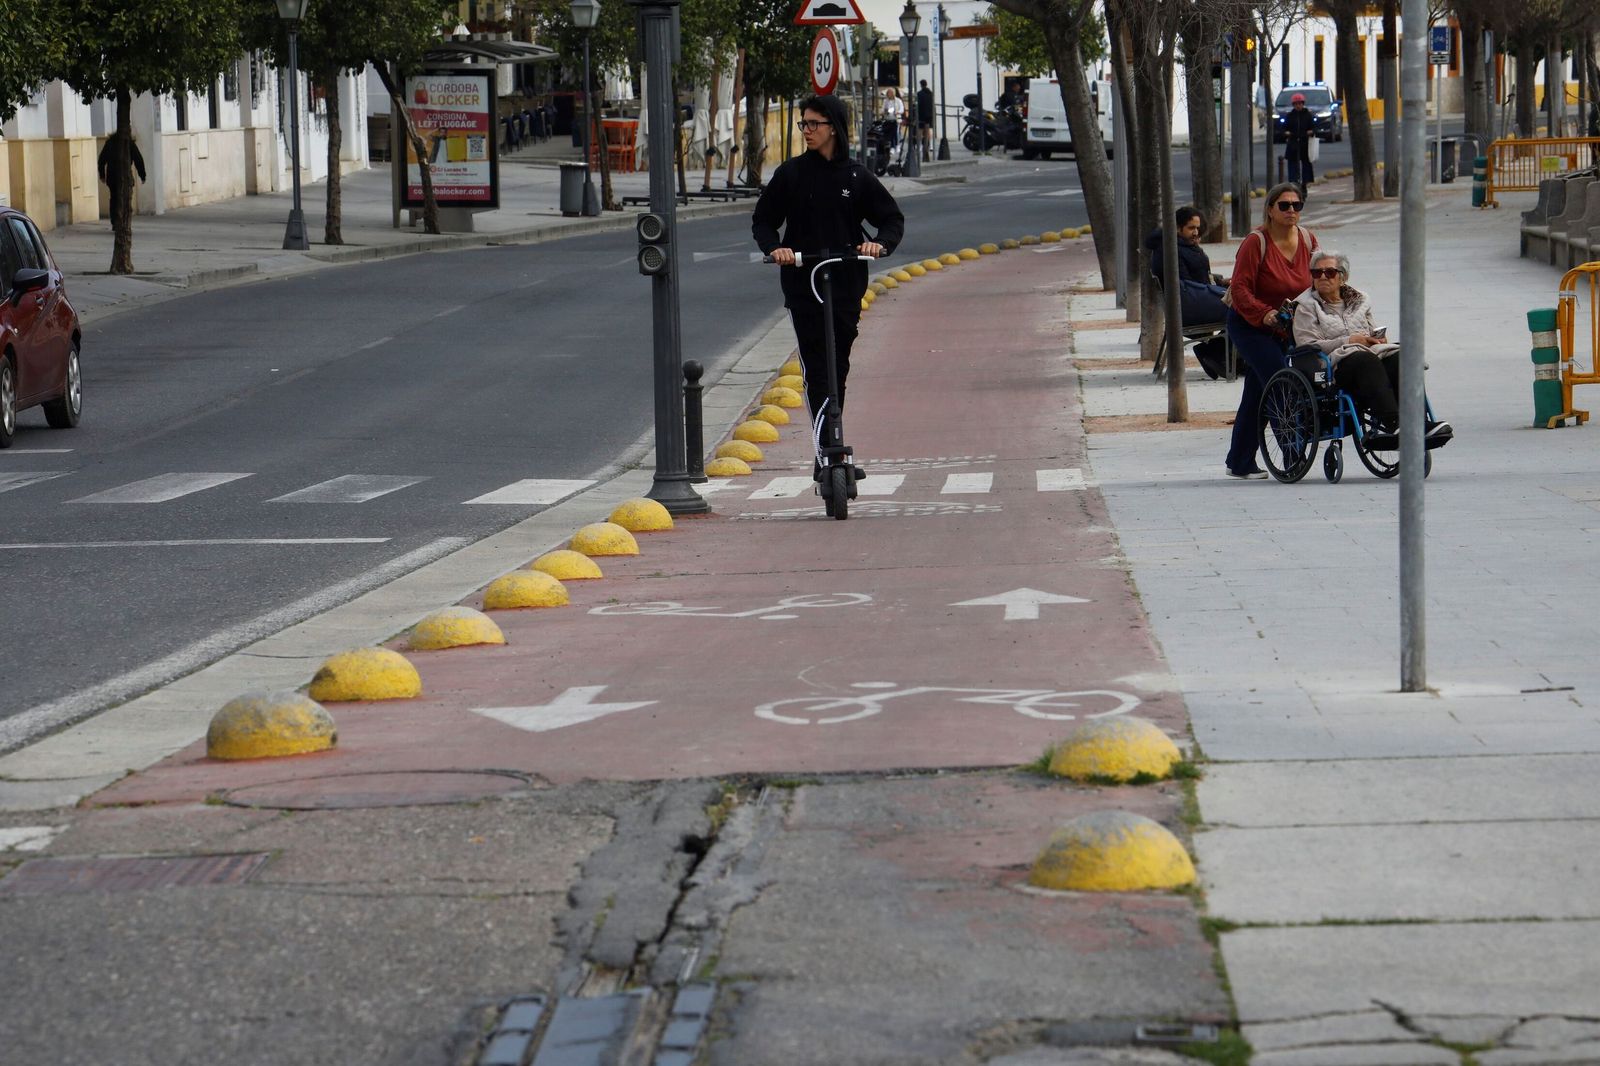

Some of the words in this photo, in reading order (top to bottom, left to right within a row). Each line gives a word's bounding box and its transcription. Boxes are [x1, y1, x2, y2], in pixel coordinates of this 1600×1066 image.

[816, 51, 831, 74] 30
[430, 94, 479, 105] LOCKER
[427, 112, 468, 120] CONSIGNA
